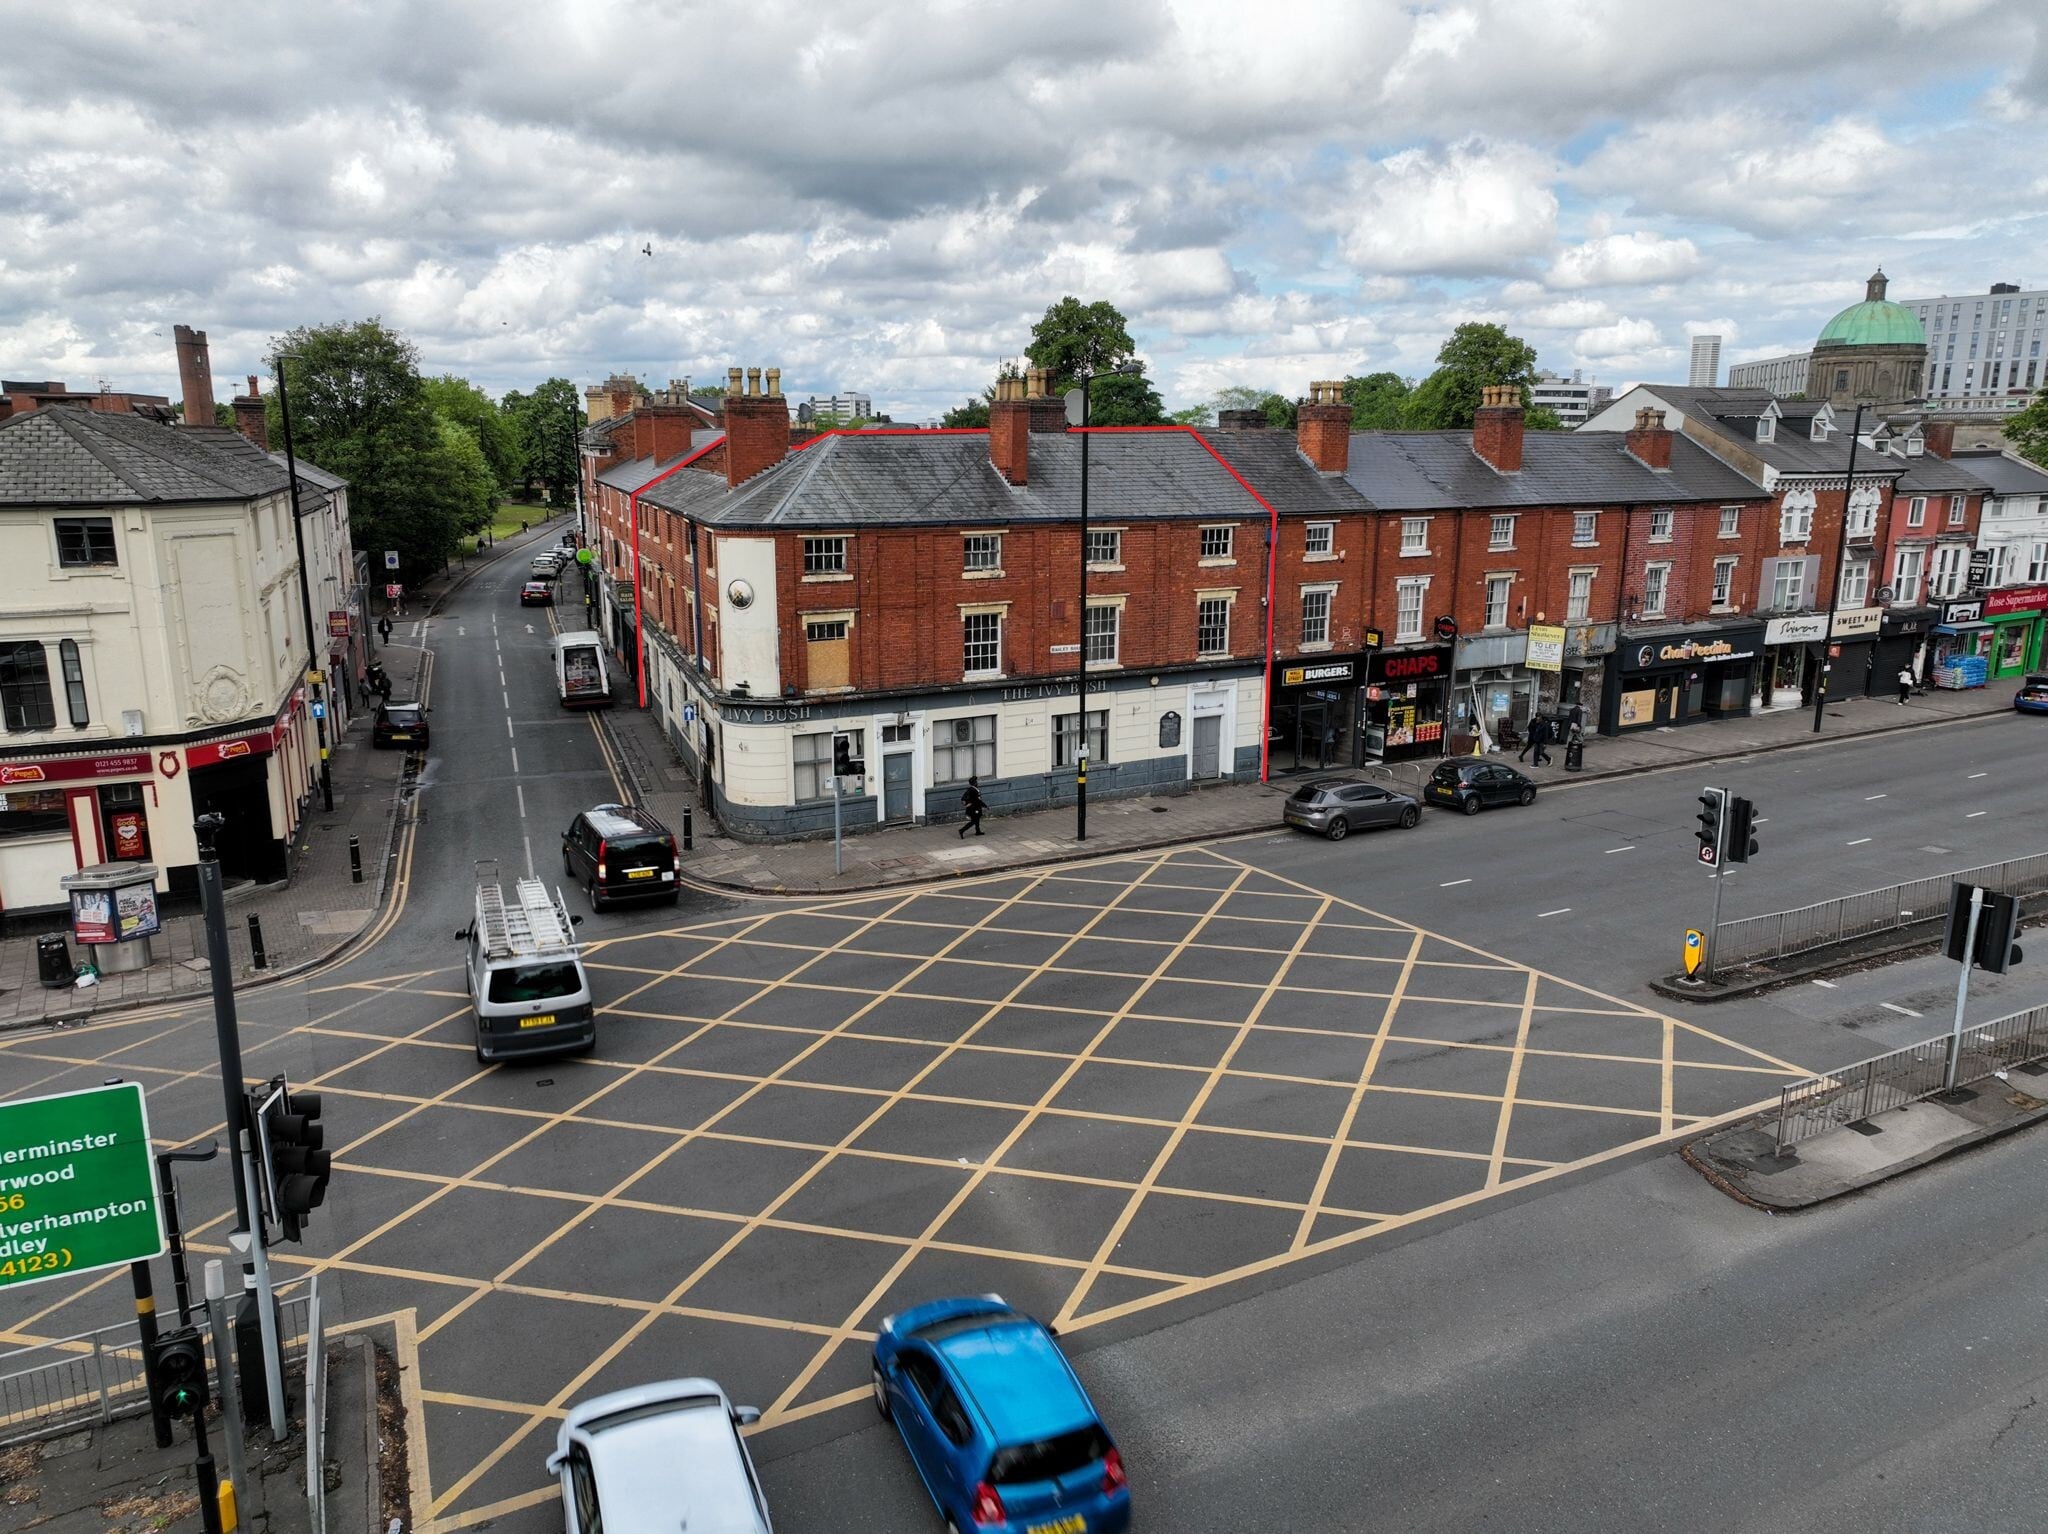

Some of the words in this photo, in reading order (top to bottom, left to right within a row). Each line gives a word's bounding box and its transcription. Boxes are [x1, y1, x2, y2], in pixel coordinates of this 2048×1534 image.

[1988, 595, 2005, 608] Rose
[2005, 590, 2047, 609] Supermarket
[1837, 615, 1861, 626] SWEET
[1864, 613, 1879, 623] BAE
[1305, 666, 1351, 680] BURGERS.
[1385, 655, 1438, 677] CHAPS
[1001, 687, 1032, 700] THE
[1038, 684, 1063, 697] IVY
[1070, 680, 1106, 694] BSH
[728, 707, 755, 722] IVY
[763, 706, 811, 722] BUSH
[95, 760, 109, 768] 0121
[15, 769, 38, 778] Pepe's
